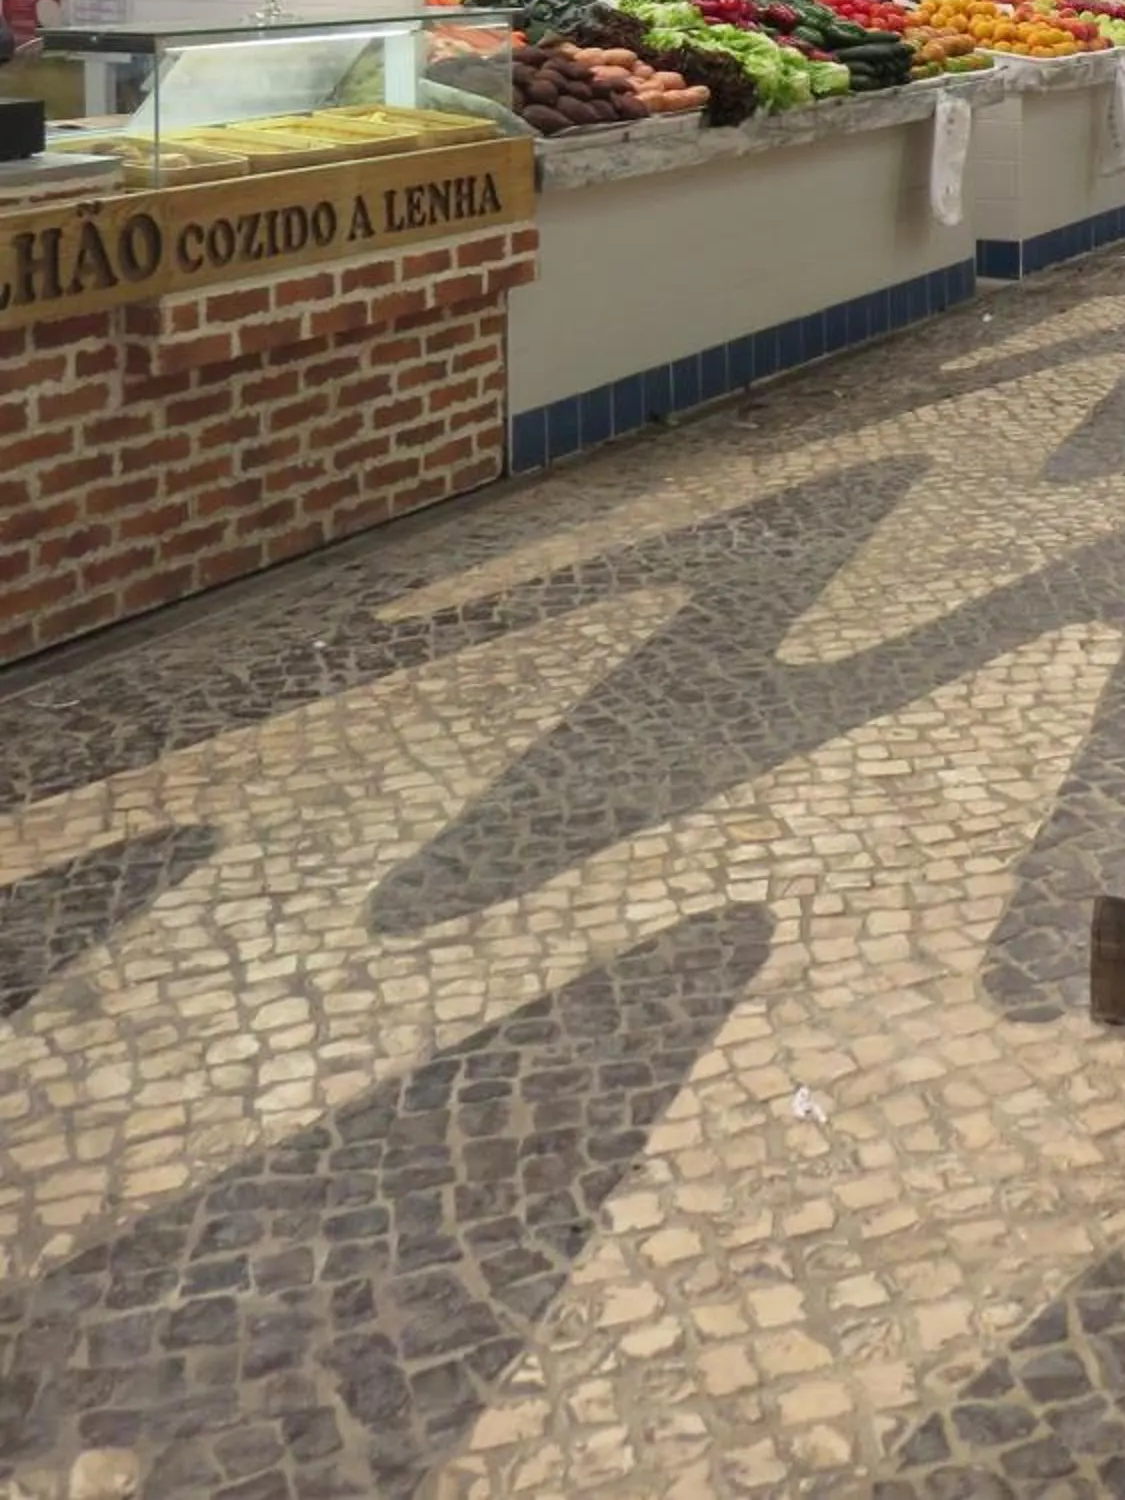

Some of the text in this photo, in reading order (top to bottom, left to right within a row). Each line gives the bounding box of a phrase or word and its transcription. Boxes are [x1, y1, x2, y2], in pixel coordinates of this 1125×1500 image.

[0, 173, 502, 311] HÃO COZIDO A LENHA
